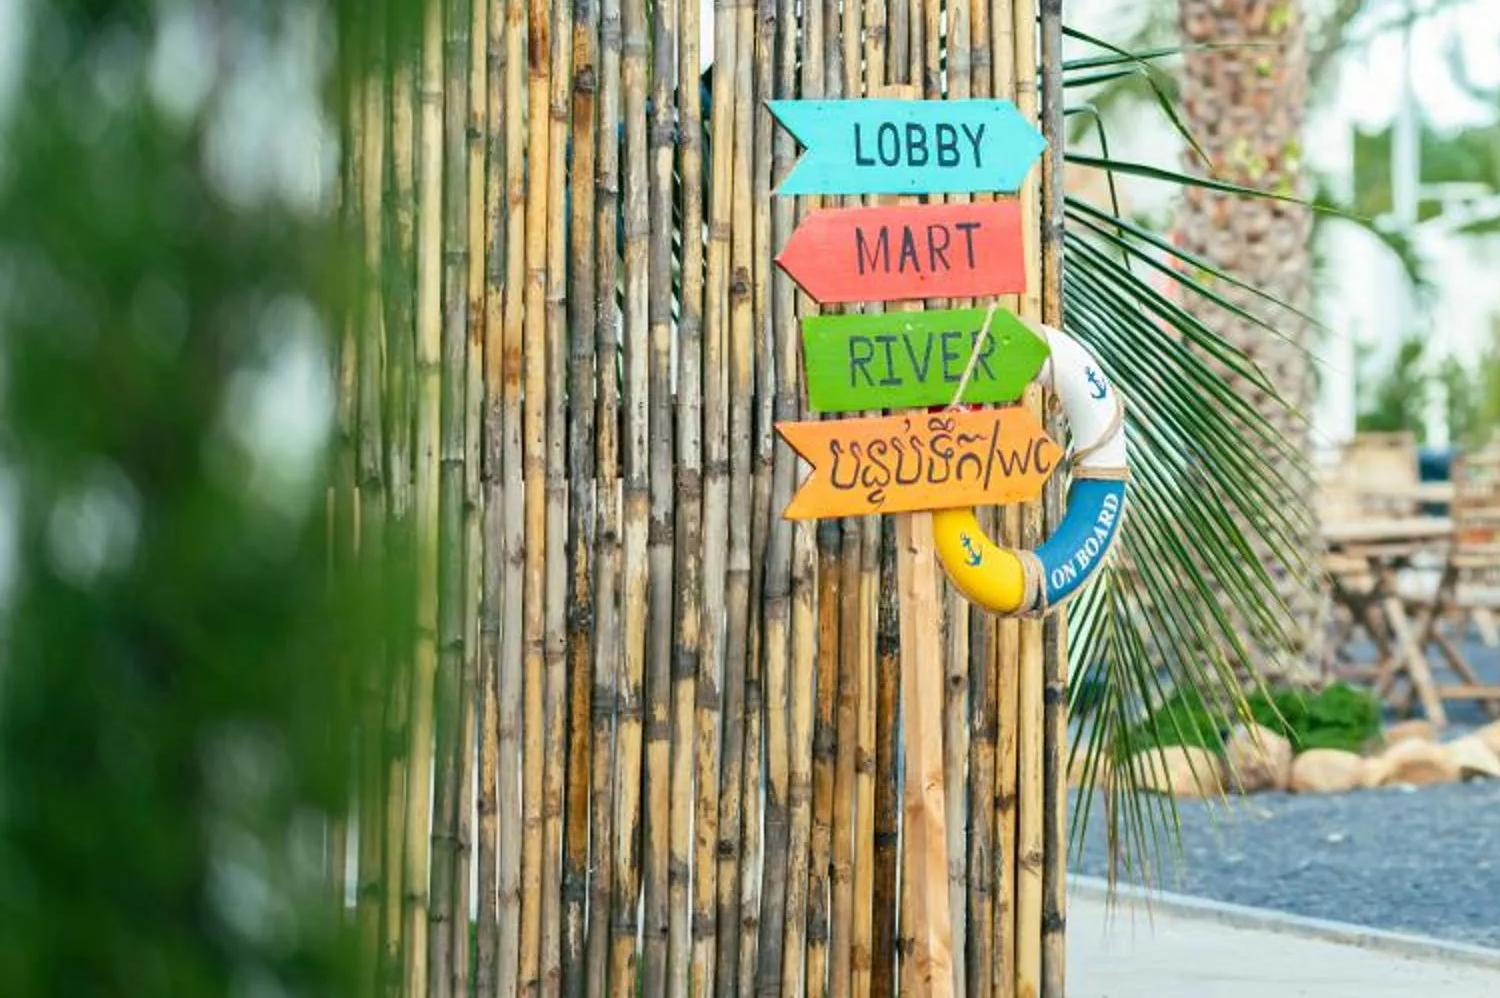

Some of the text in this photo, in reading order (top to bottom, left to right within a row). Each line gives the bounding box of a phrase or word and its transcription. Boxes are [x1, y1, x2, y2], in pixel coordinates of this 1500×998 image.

[853, 122, 986, 168] LOBBY
[855, 221, 981, 276] MART
[848, 330, 997, 388] RIVER
[1051, 492, 1119, 589] ON BOARD
